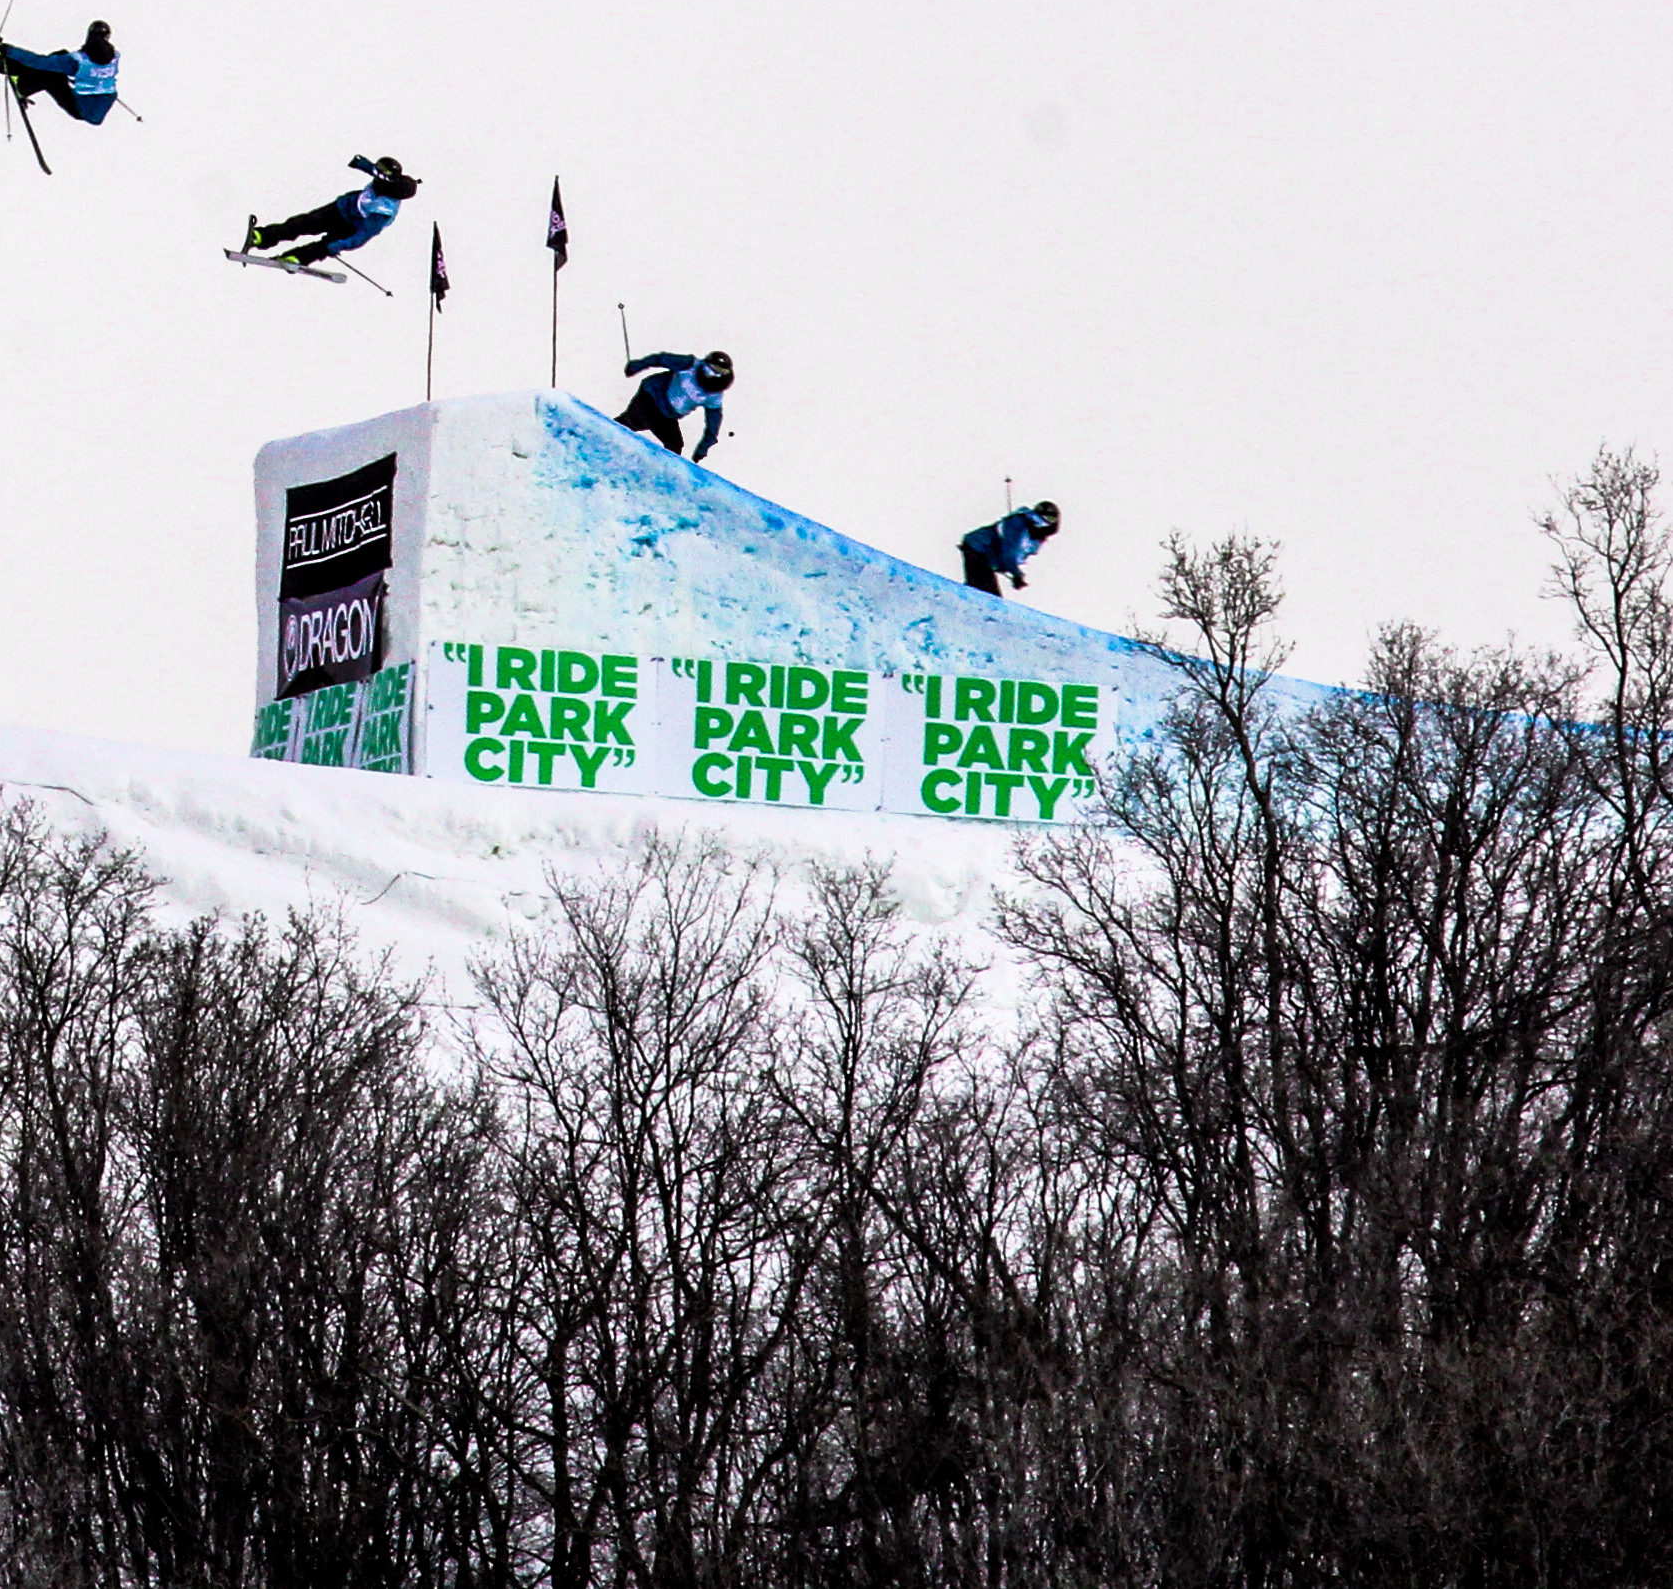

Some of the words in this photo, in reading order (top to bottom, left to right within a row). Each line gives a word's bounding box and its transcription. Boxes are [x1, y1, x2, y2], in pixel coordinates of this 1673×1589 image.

[288, 521, 320, 560] PAUL
[298, 595, 380, 672] DRAGON
[497, 645, 639, 699] RIDE
[725, 661, 870, 714] RIDE
[466, 690, 636, 746] PARK
[954, 676, 1100, 729] RIDE
[694, 705, 865, 762] PARK
[923, 721, 1096, 776] PARK
[464, 736, 636, 788] CITY”
[691, 751, 865, 805] CITY”
[920, 767, 1096, 820] CITY”
